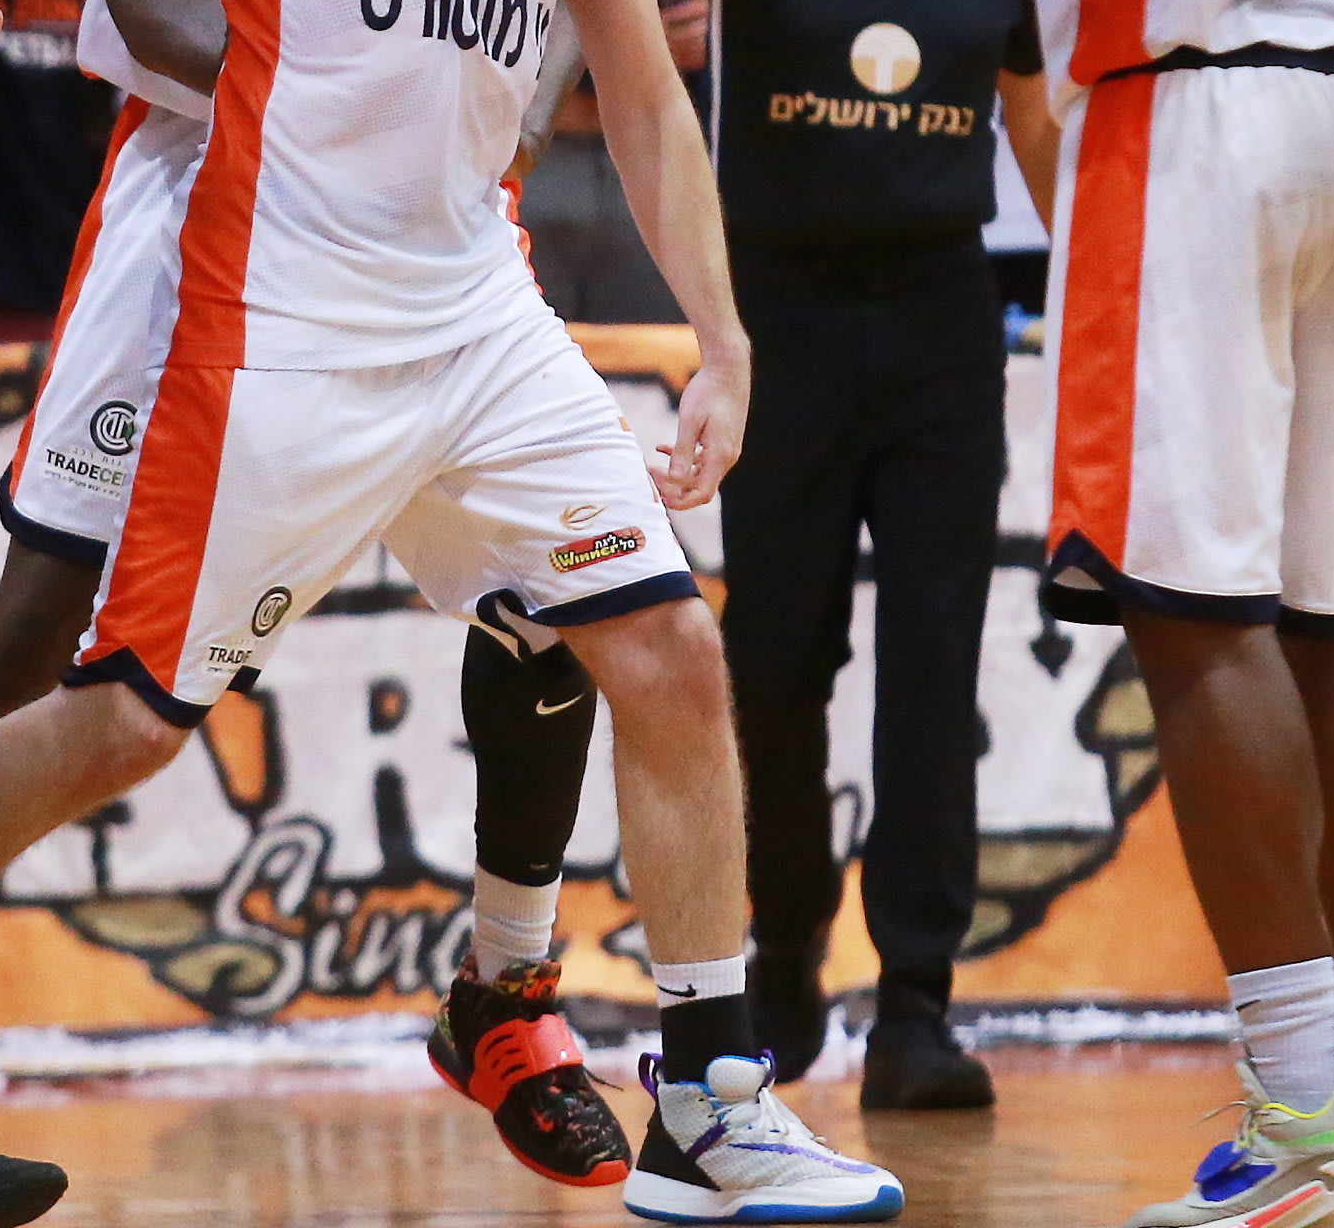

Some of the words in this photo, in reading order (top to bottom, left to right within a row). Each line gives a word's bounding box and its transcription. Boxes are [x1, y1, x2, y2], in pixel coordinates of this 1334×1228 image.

[769, 91, 911, 131] ירושלים
[46, 449, 126, 486] TRADECE
[557, 543, 619, 568] Winner
[212, 818, 475, 1015] Sinc
